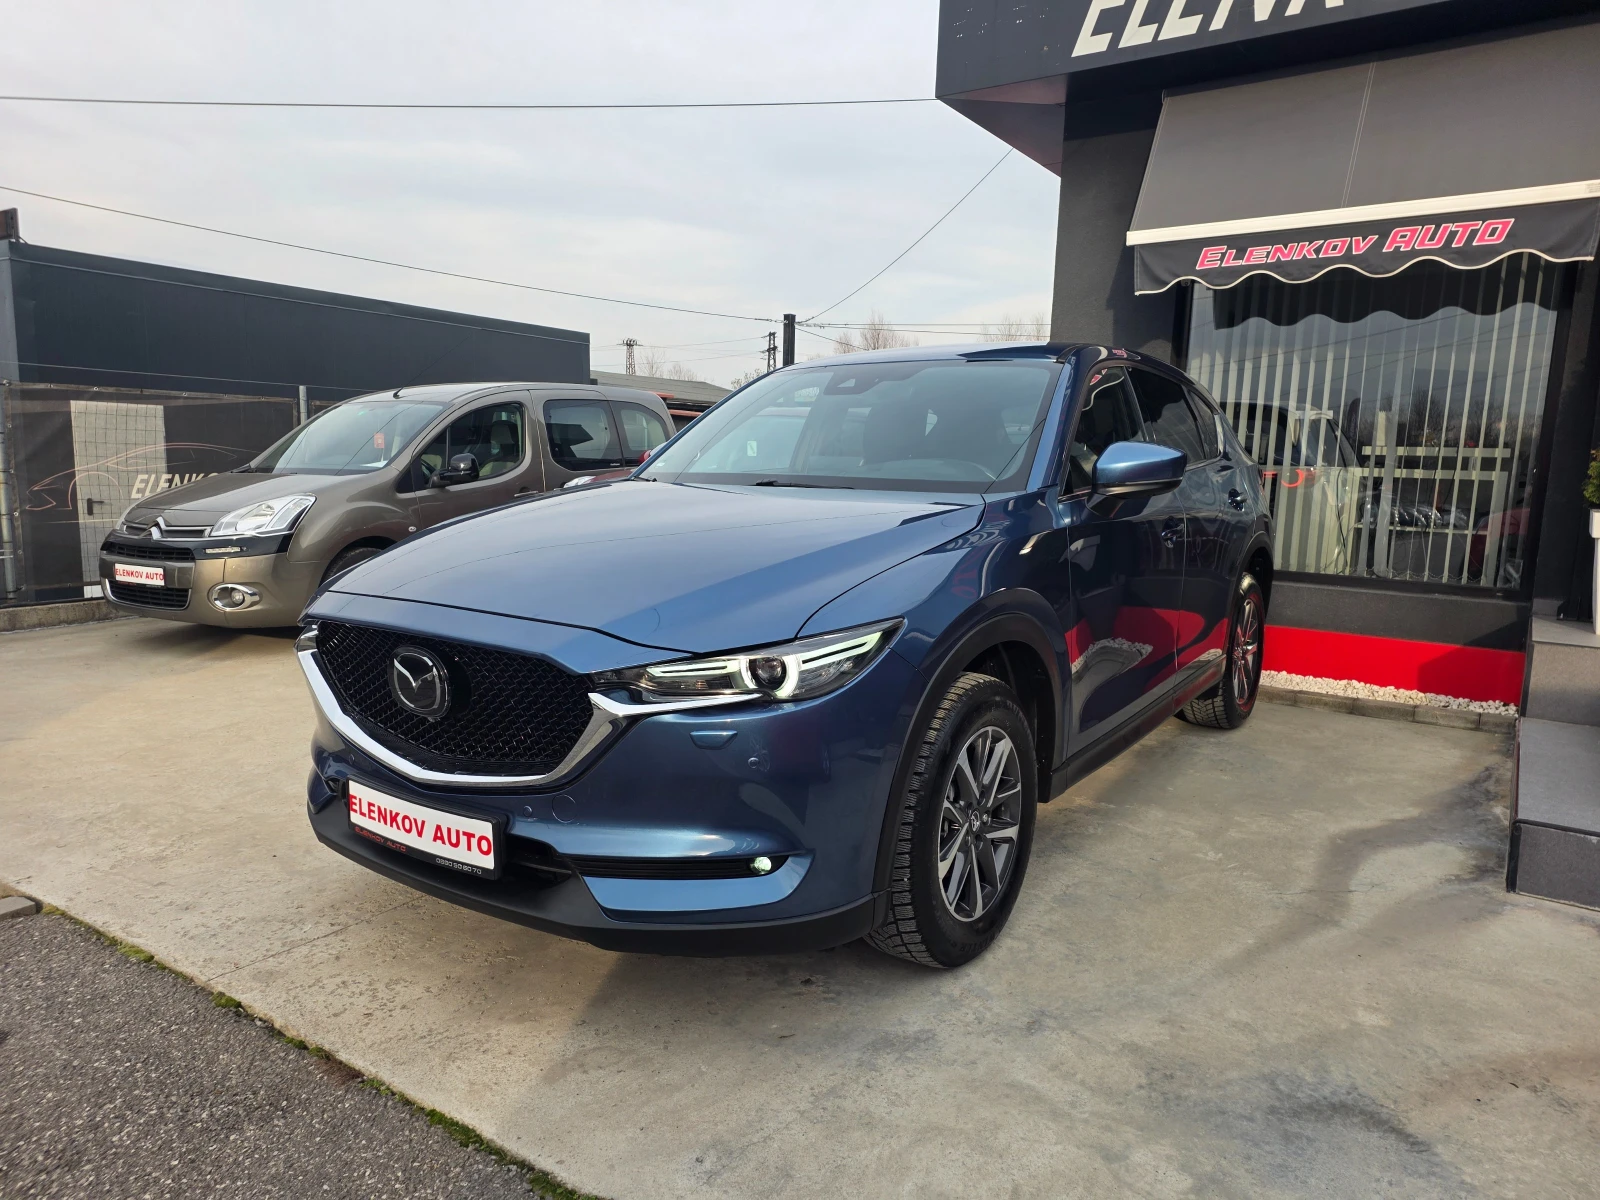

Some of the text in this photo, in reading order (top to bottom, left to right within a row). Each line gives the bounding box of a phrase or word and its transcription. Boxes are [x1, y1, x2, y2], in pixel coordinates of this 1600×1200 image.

[1196, 218, 1514, 270] ELENKOV AUTO
[115, 568, 164, 581] ELENKOV AUTO
[349, 793, 492, 856] ELENKOV AUTO
[386, 840, 406, 852] AUTO
